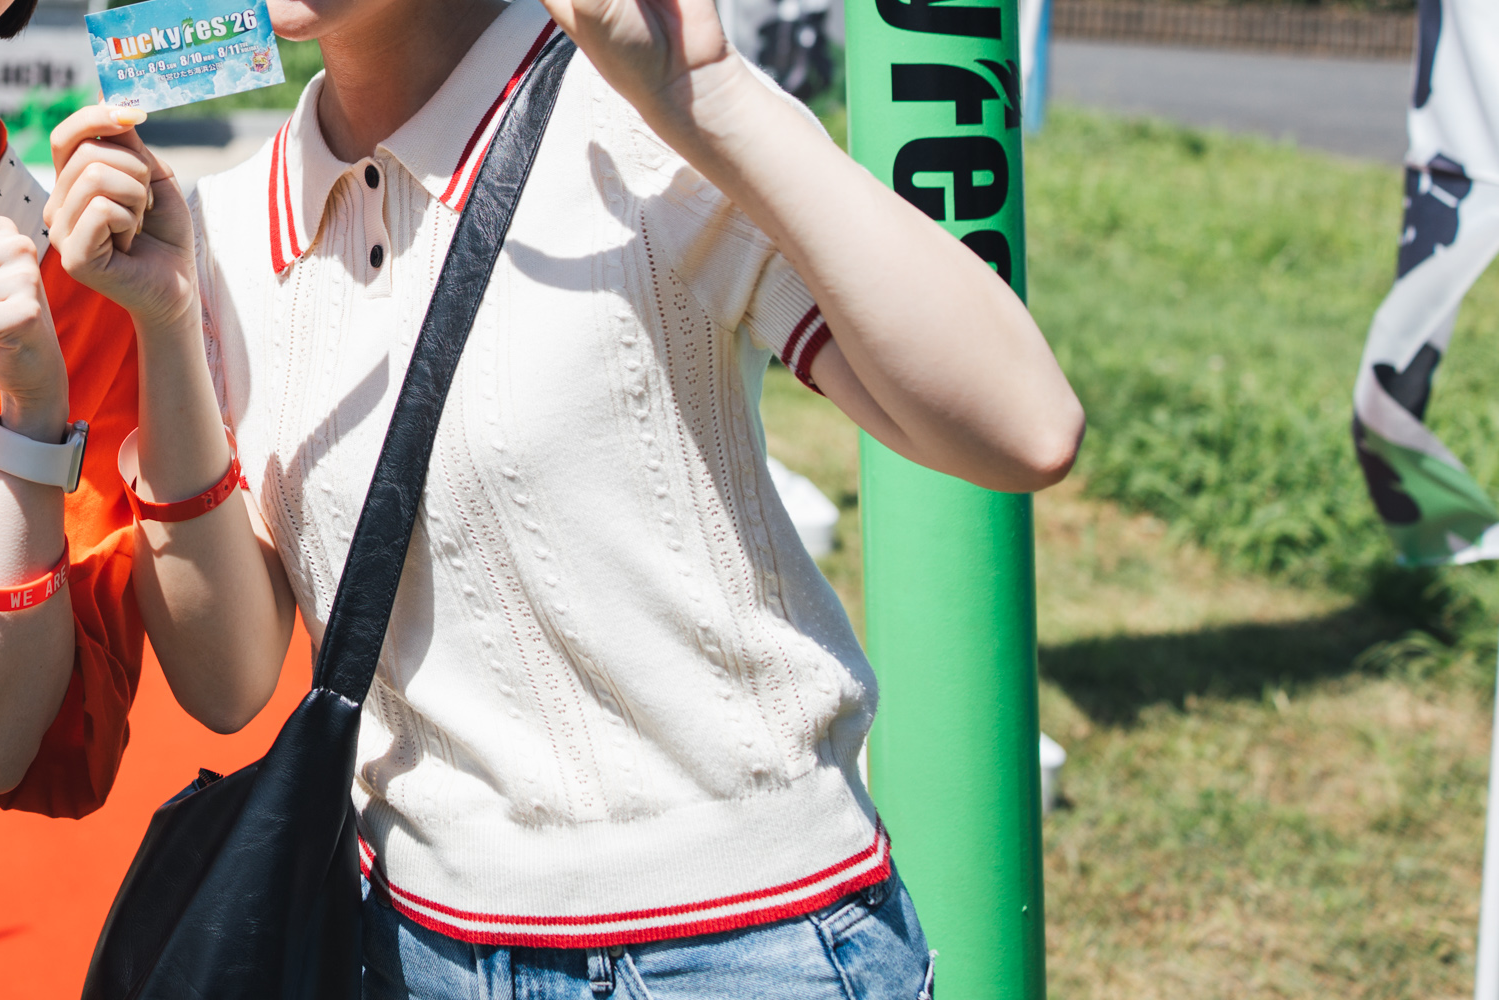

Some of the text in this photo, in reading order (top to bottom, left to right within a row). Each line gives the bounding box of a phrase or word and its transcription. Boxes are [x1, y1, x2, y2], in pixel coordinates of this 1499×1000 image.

[117, 67, 135, 81] 8/8
[148, 60, 166, 74] 8/9
[180, 51, 203, 67] 8/10
[217, 43, 241, 58] 8/11
[10, 589, 33, 608] WE
[45, 565, 66, 597] ARE
